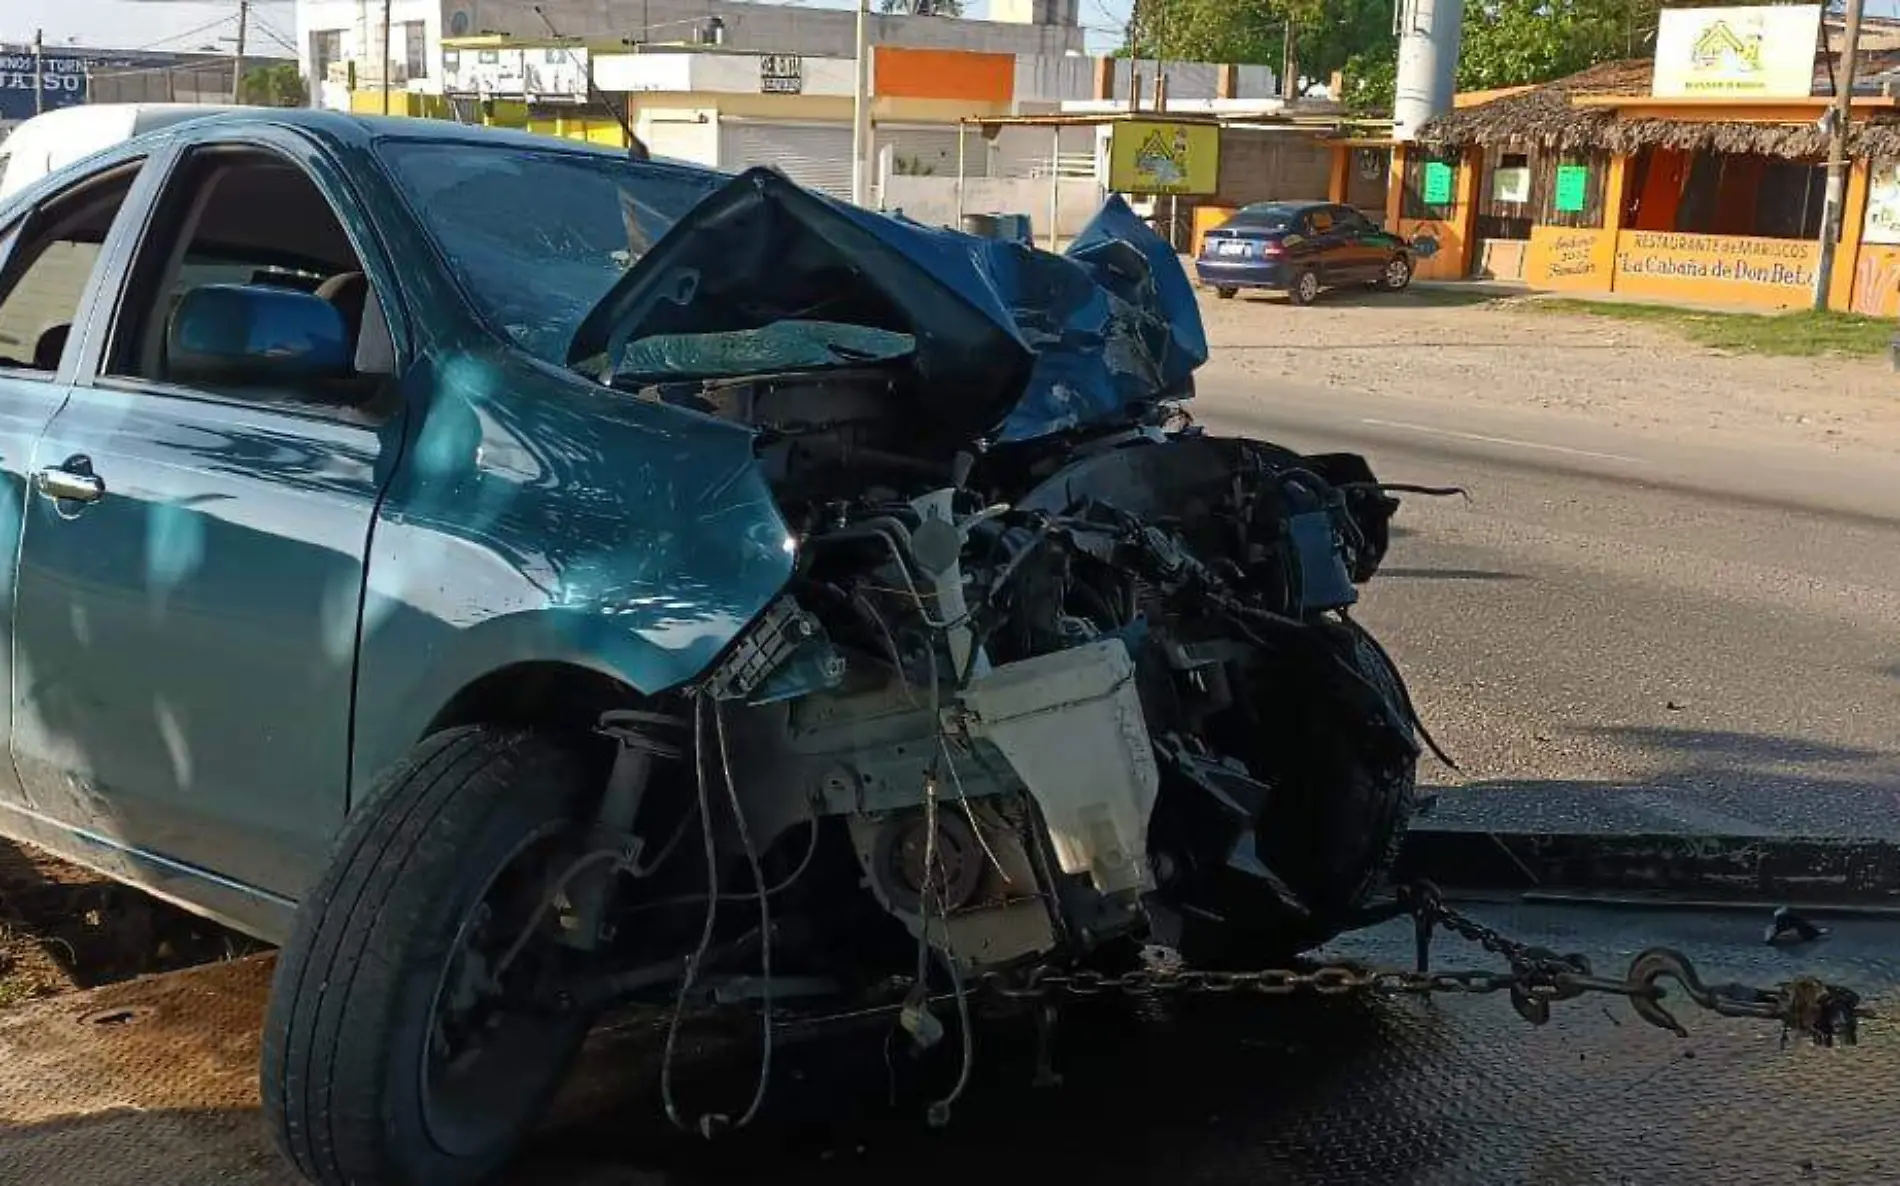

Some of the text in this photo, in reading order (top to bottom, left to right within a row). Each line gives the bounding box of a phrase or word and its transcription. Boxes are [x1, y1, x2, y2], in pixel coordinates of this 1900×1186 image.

[1635, 234, 1719, 252] RESTAURANTE
[1646, 255, 1706, 276] Cabaña
[1712, 259, 1731, 278] de
[1735, 259, 1767, 281] Don
